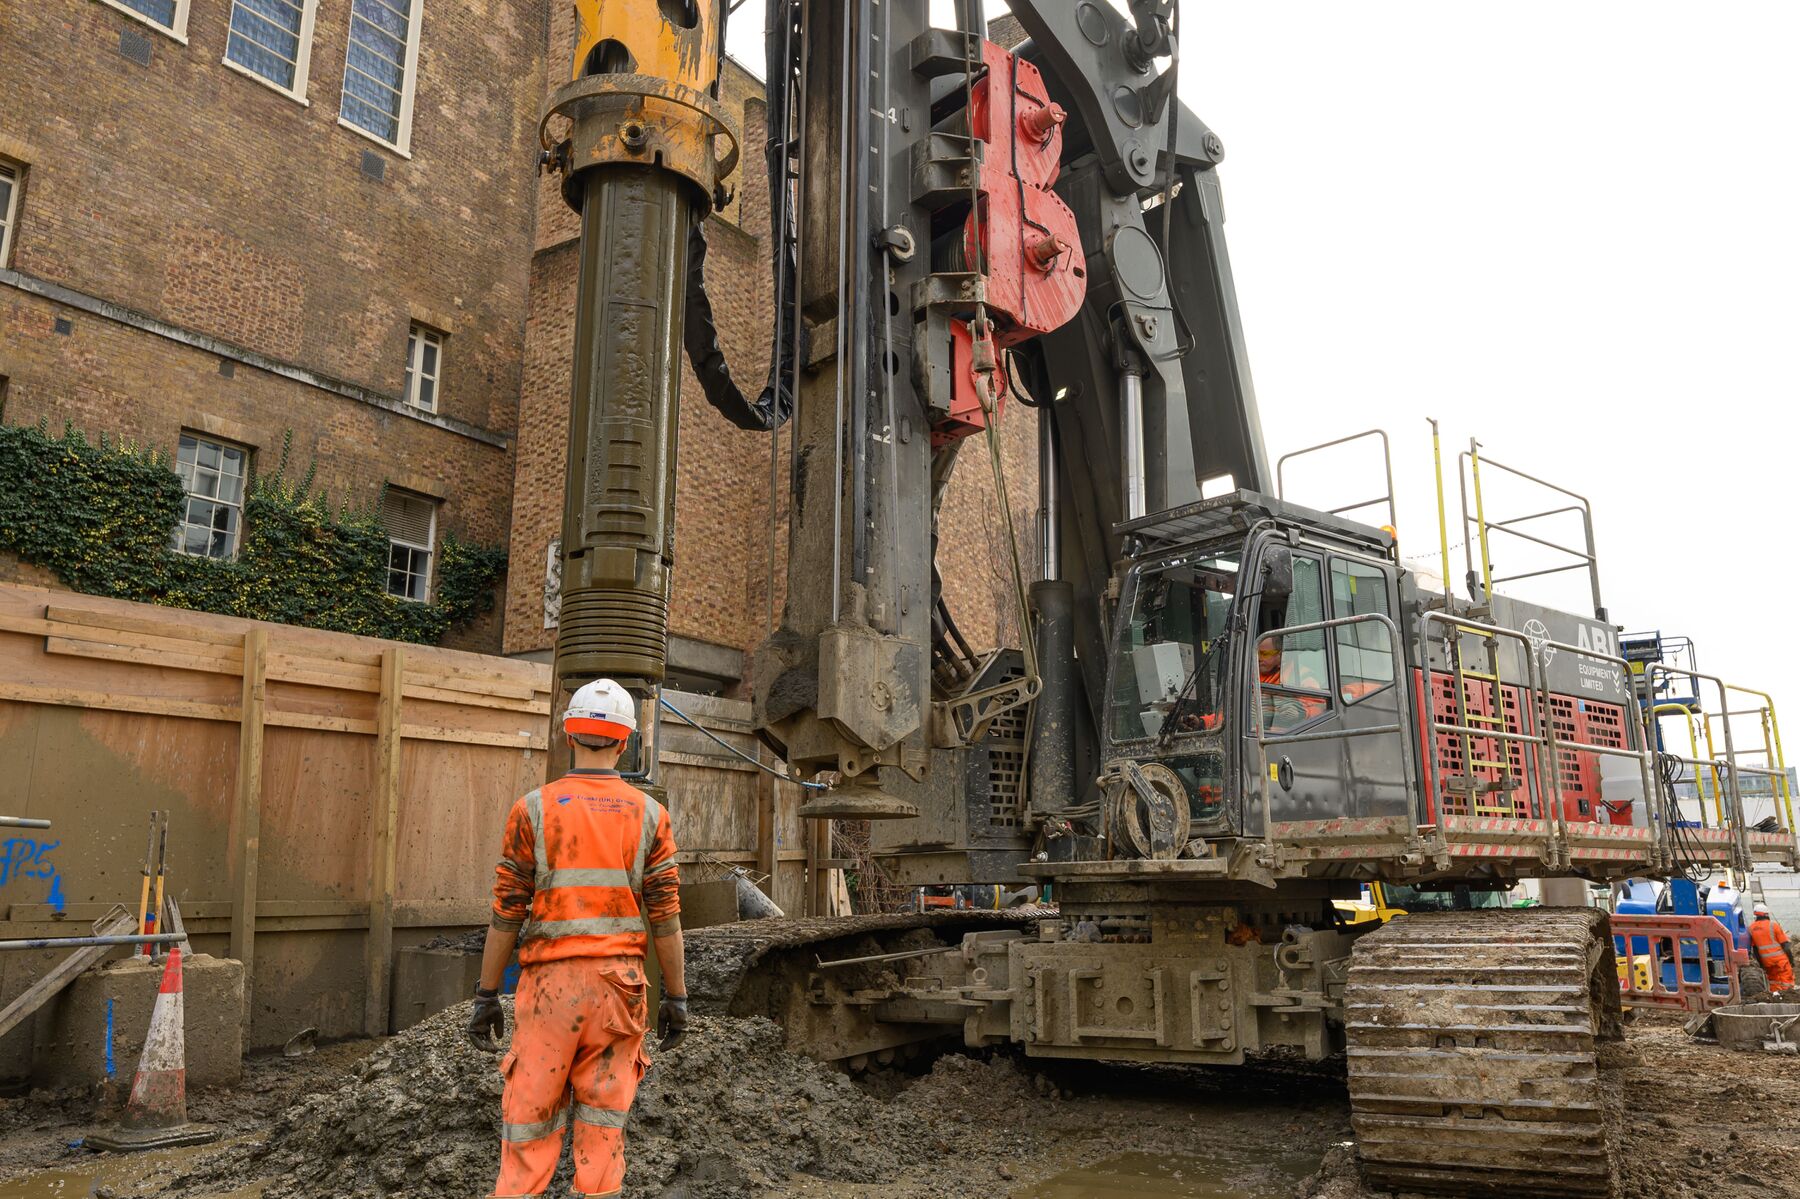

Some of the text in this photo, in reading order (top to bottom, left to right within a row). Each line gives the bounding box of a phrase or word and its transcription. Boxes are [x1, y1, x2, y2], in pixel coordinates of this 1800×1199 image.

[887, 107, 897, 124] 4
[882, 425, 891, 444] 2
[1577, 623, 1617, 666] ABI
[1578, 664, 1612, 680] EQUIPMENT
[1580, 678, 1604, 691] LIMITED
